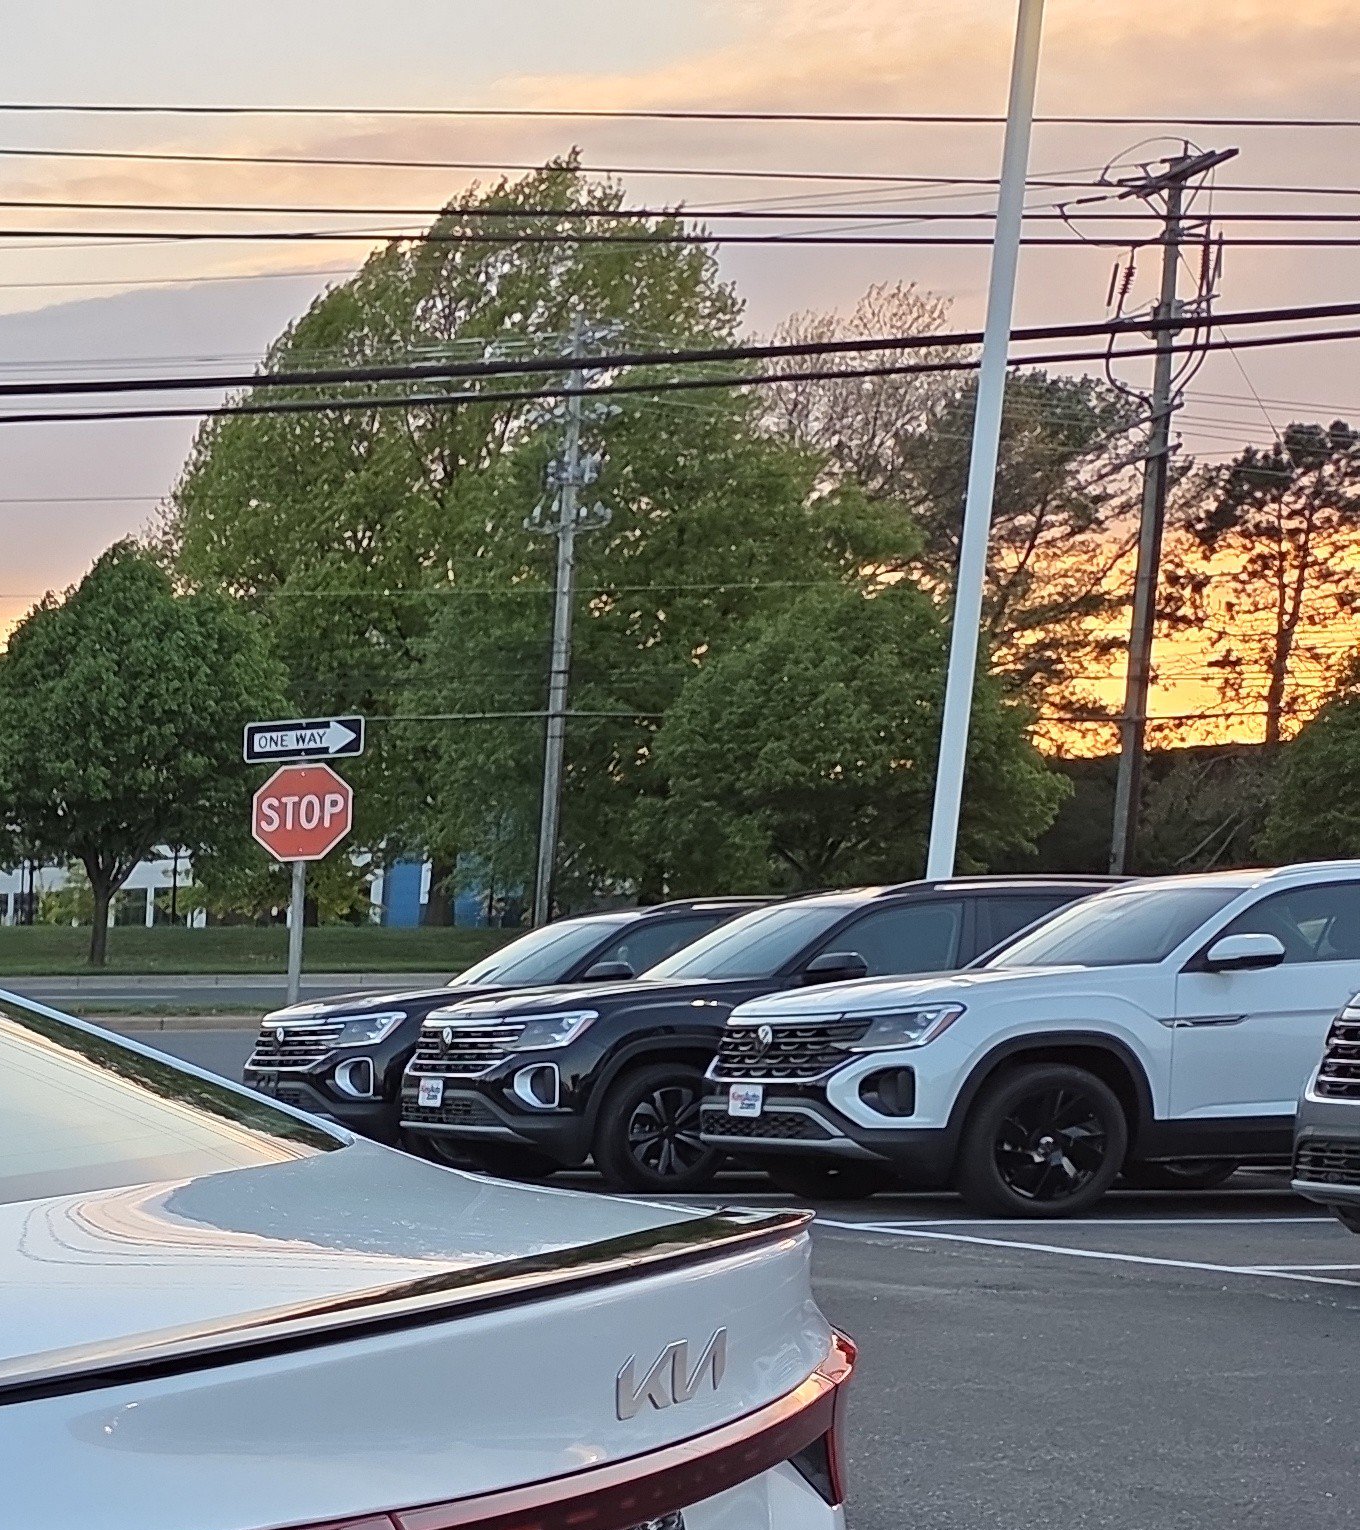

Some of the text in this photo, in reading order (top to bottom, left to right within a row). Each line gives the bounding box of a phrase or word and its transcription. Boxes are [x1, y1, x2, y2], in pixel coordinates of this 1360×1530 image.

[258, 731, 327, 749] ONE WAY
[260, 793, 345, 833] STOP
